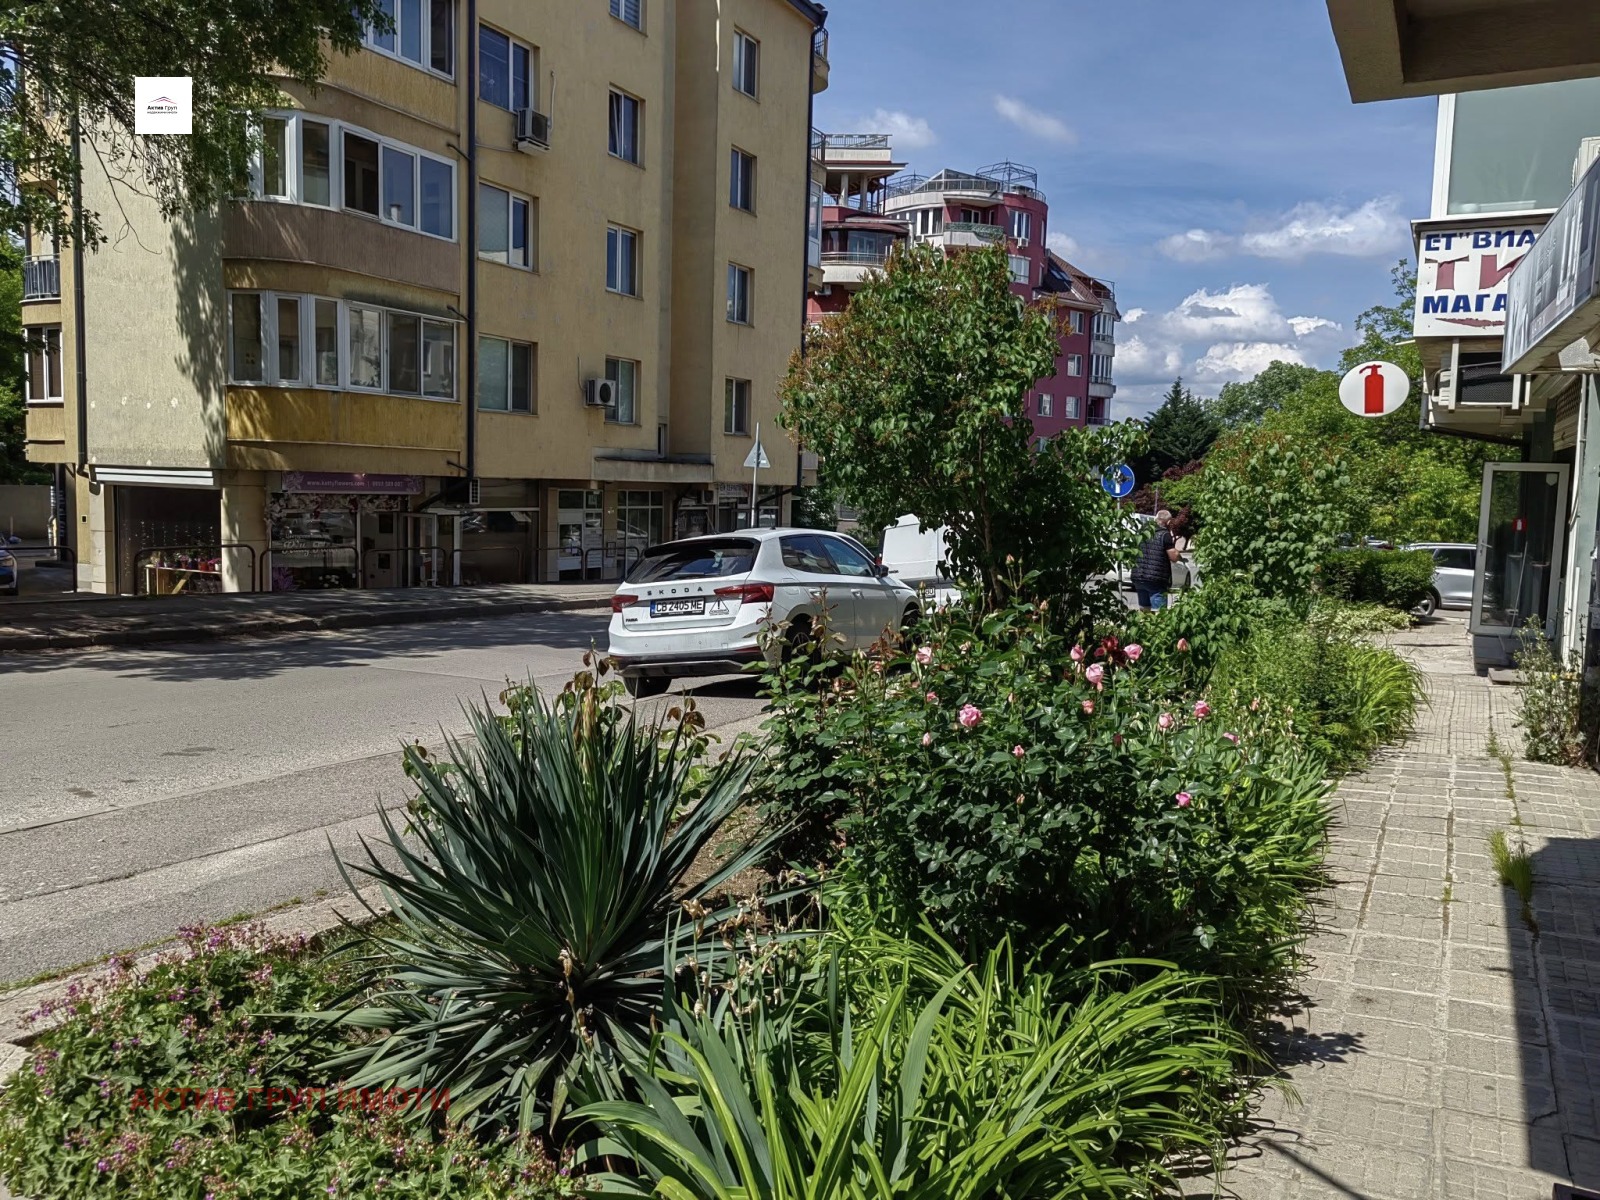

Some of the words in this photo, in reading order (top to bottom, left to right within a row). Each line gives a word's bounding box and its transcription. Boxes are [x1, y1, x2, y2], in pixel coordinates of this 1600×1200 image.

[656, 602, 668, 612] CB
[669, 601, 690, 612] 2405
[690, 600, 703, 610] ME
